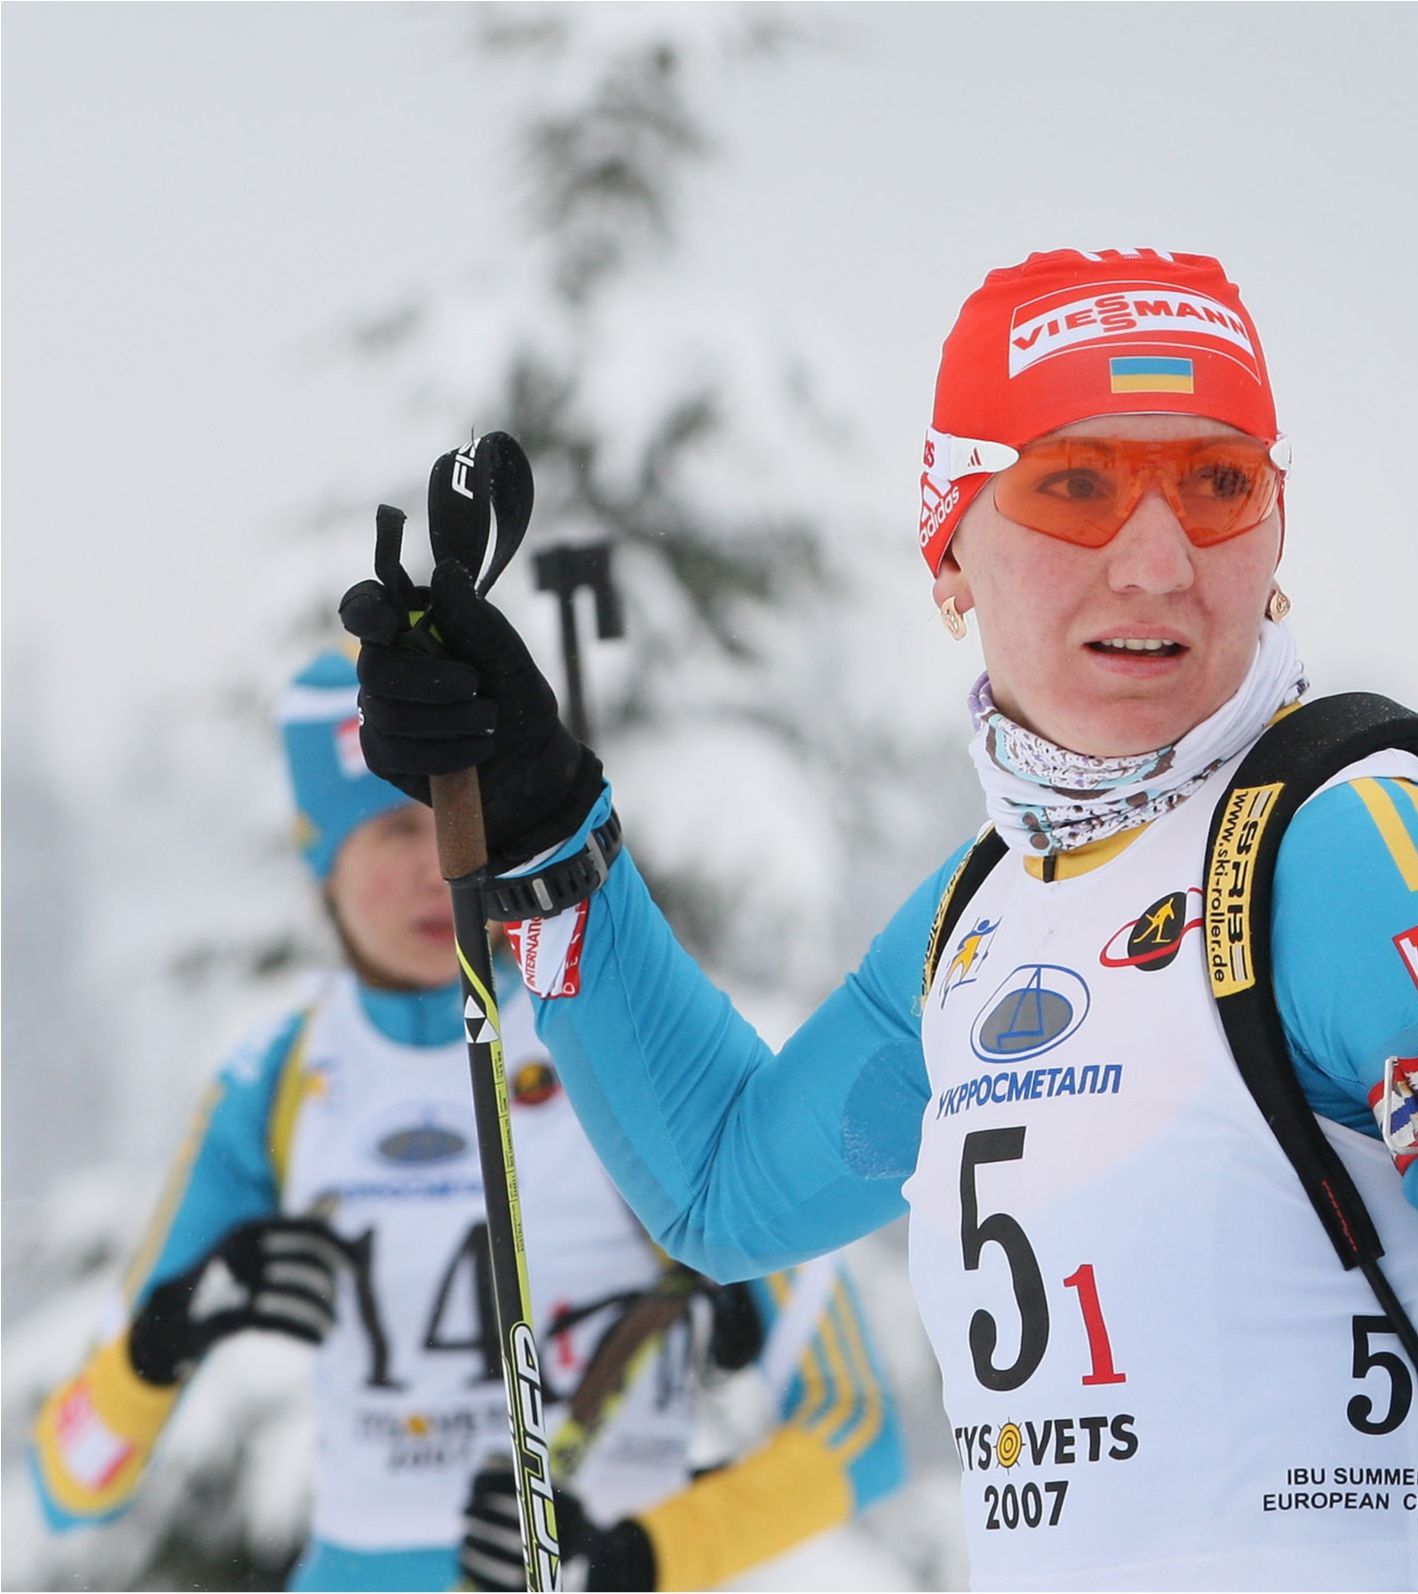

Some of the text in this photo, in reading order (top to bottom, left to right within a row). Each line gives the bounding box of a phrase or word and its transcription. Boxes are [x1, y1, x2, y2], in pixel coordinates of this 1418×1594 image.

[1012, 295, 1247, 351] VIESSMANN
[919, 486, 960, 547] adidas
[1209, 792, 1249, 984] www.ski-roller.de
[936, 1064, 1123, 1121] УКРРОСМЕТАЛЛ
[960, 1125, 1050, 1392] 5
[1063, 1264, 1127, 1386] 1
[1347, 1315, 1413, 1435] 5
[984, 1481, 1069, 1530] 2007
[1263, 1492, 1390, 1512] EUROPEAN
[1287, 1468, 1326, 1486] IBU
